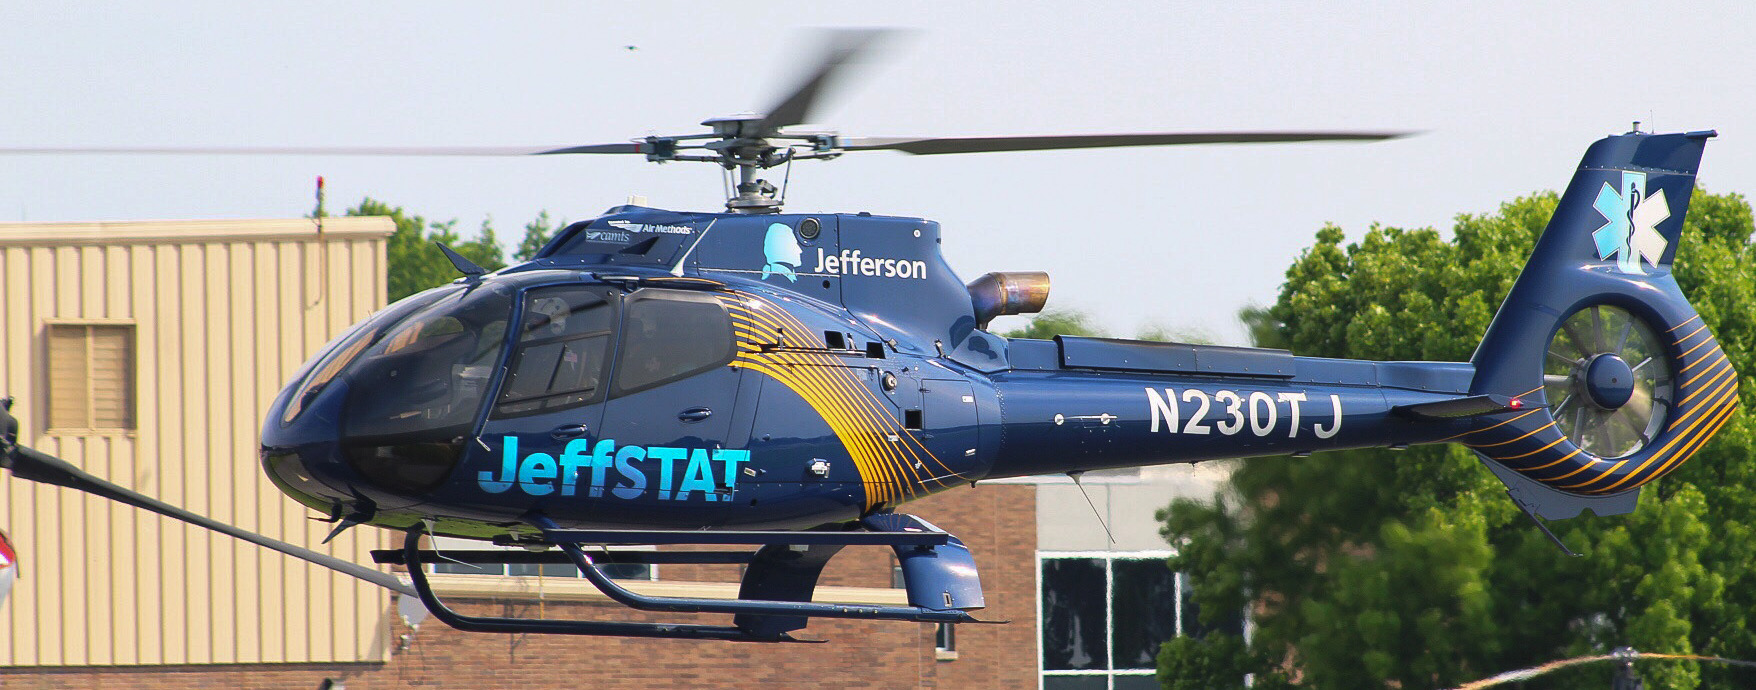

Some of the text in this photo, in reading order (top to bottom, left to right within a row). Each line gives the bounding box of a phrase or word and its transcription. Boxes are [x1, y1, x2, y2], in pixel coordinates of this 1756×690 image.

[643, 224, 692, 234] Air Methods
[814, 248, 927, 279] Jefferson
[1145, 387, 1342, 439] N230TJ
[477, 436, 750, 502] JeffSTAT
